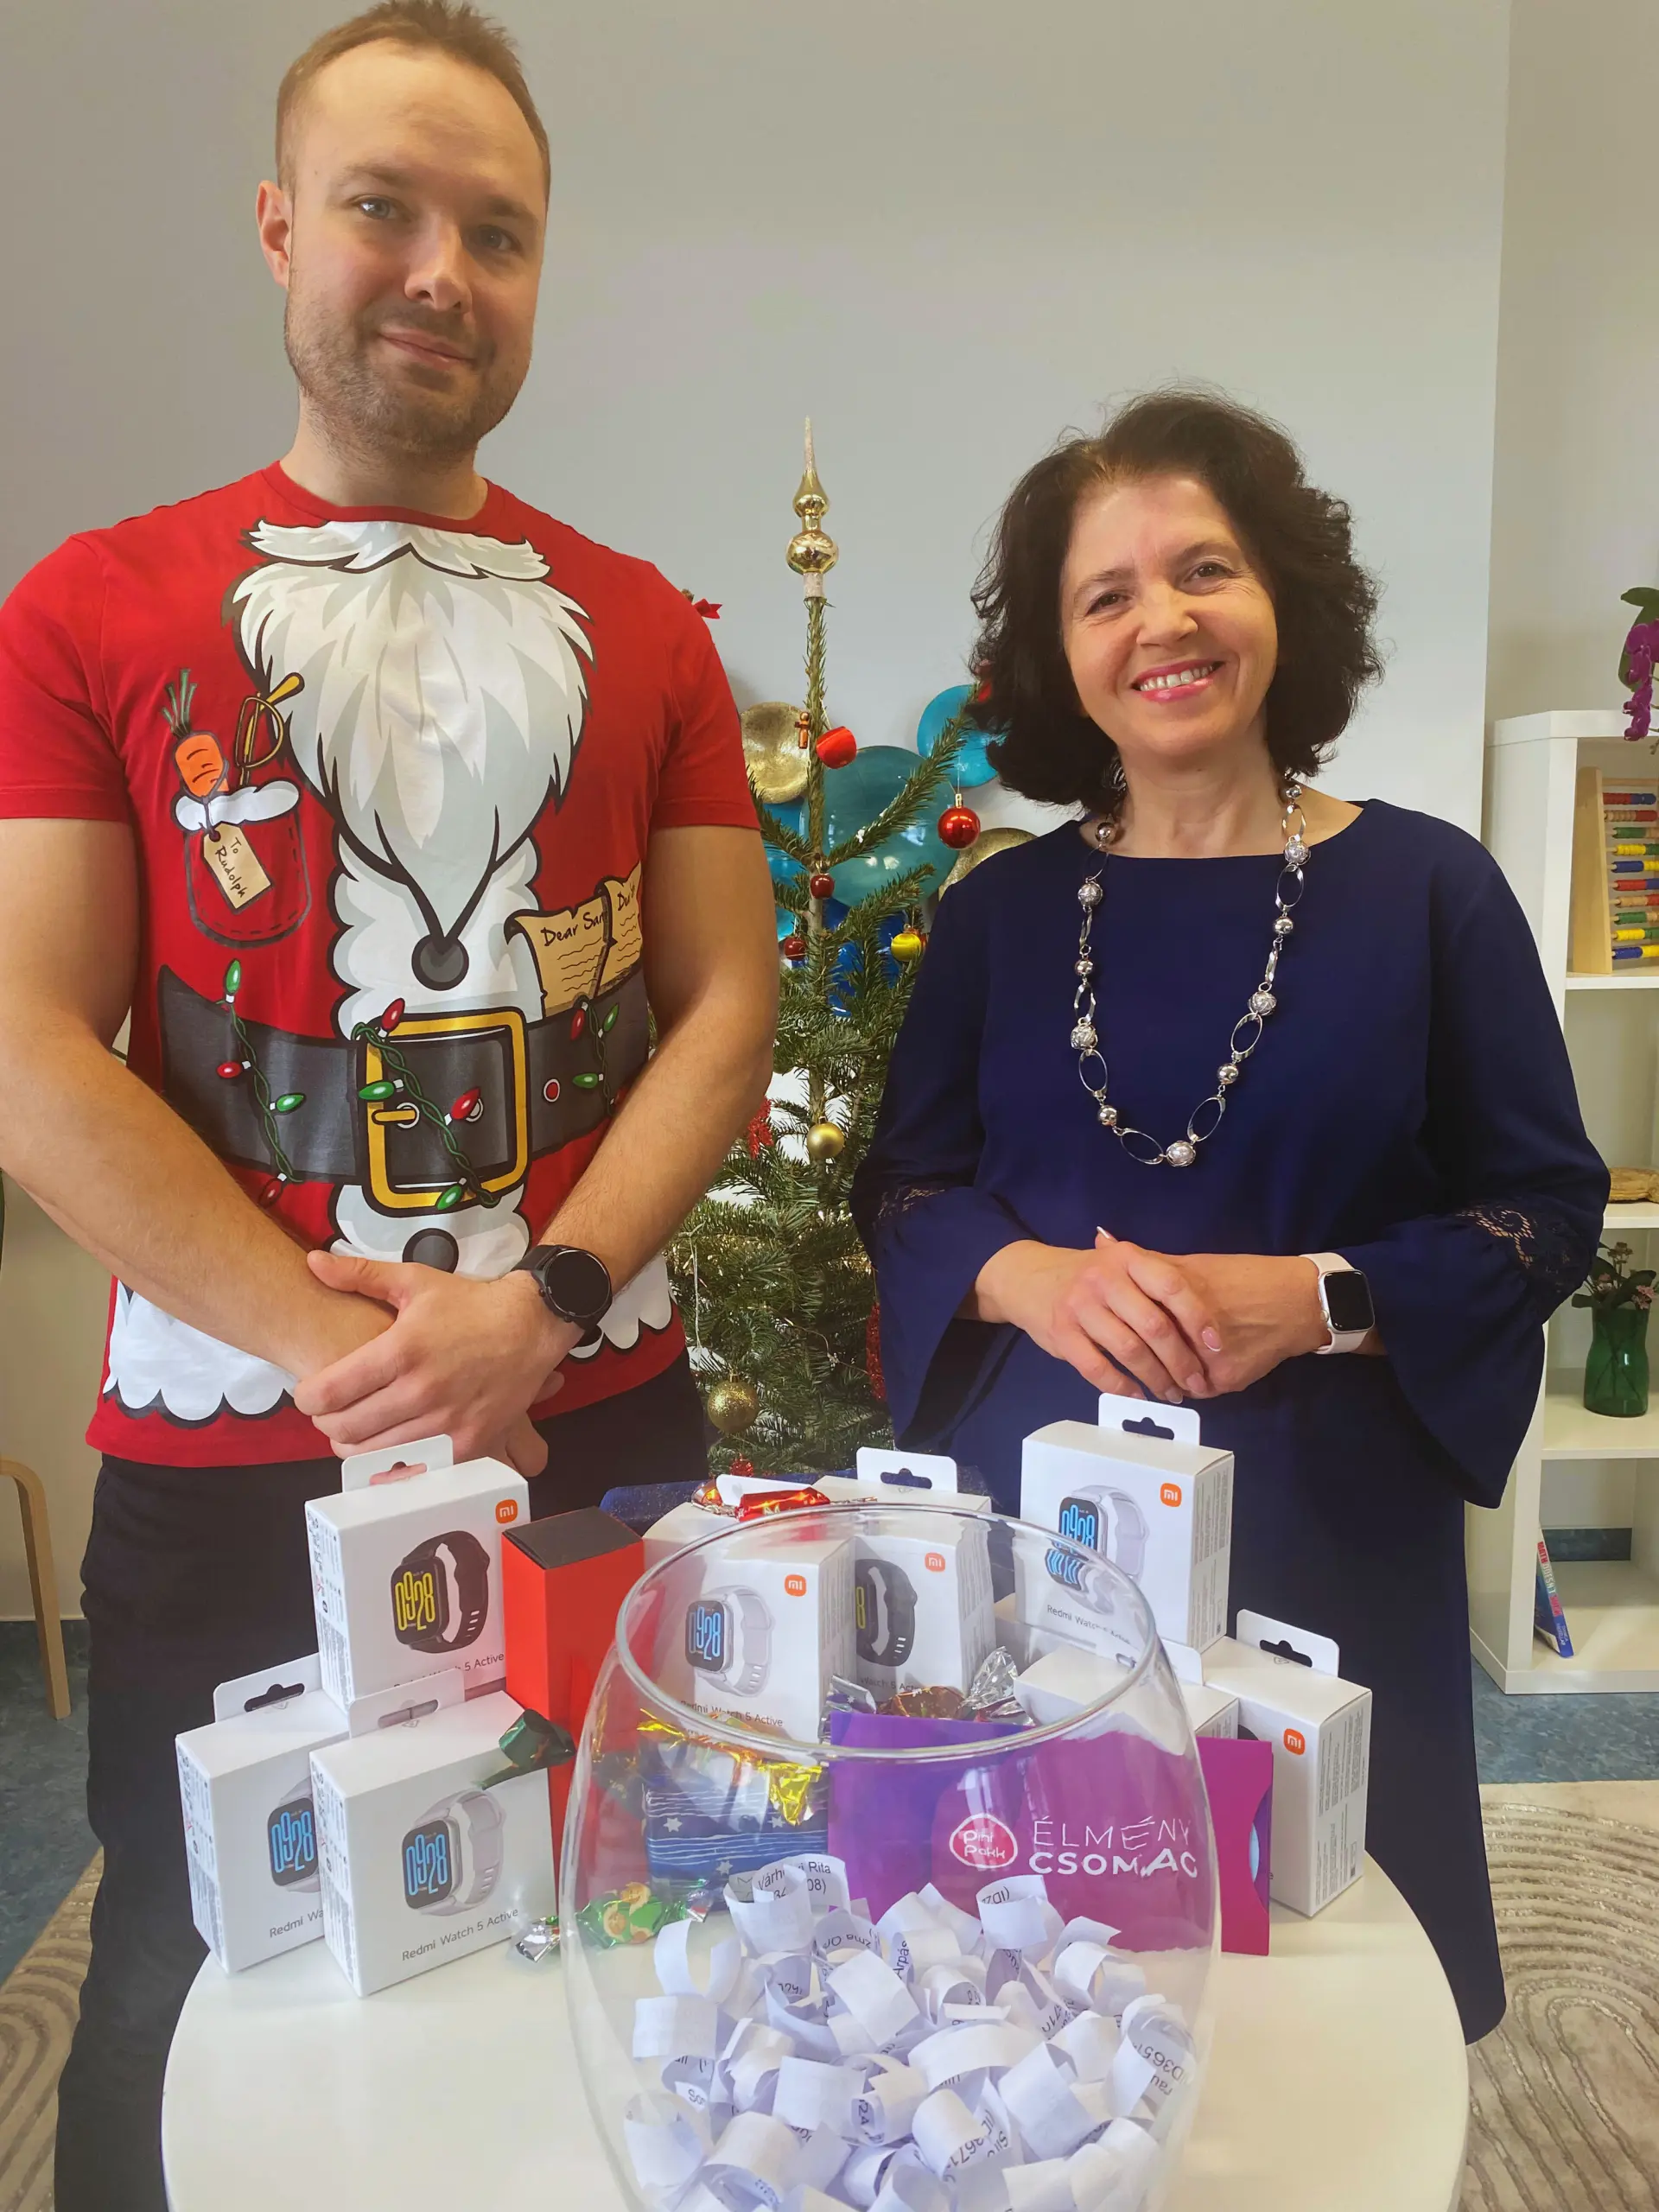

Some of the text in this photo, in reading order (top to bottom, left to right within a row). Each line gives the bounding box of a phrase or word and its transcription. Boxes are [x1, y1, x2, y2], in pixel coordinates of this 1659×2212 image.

[230, 836, 242, 854] To
[214, 844, 248, 898] Rudolph
[540, 924, 578, 947] Dear
[395, 1571, 436, 1631] 0928
[1047, 1605, 1072, 1621] Redmi
[464, 1653, 505, 1672] 5 Active
[745, 1712, 752, 1722] 5
[754, 1713, 783, 1726] Active
[271, 1811, 315, 1873] 0928
[1033, 1815, 1192, 1850] ÉLMÉNY
[406, 1834, 448, 1896] 0928
[808, 1861, 831, 1874] Rita
[270, 1916, 303, 1938] Redmi
[402, 1909, 518, 1961] Redmi Watch 5 Active
